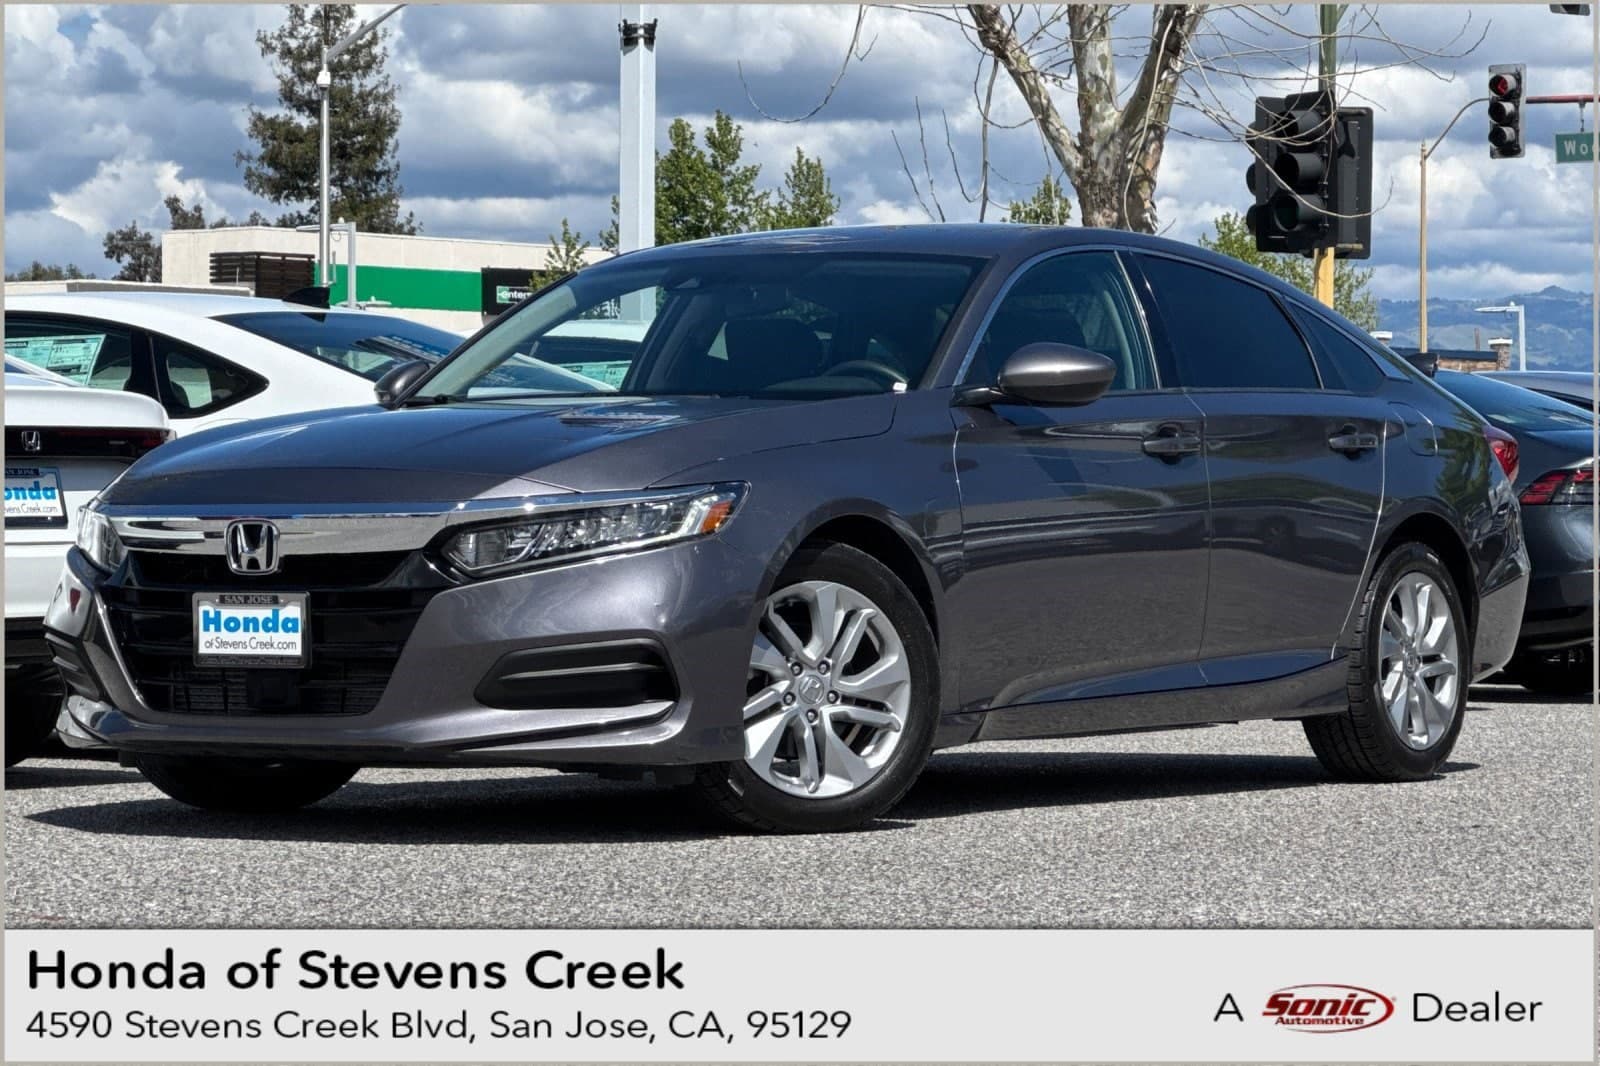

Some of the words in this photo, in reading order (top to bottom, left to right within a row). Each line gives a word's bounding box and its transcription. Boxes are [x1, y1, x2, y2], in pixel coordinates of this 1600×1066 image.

[1564, 140, 1594, 155] Wo
[224, 595, 244, 604] SAN
[247, 595, 273, 604] JOSE
[203, 609, 299, 633] Honda
